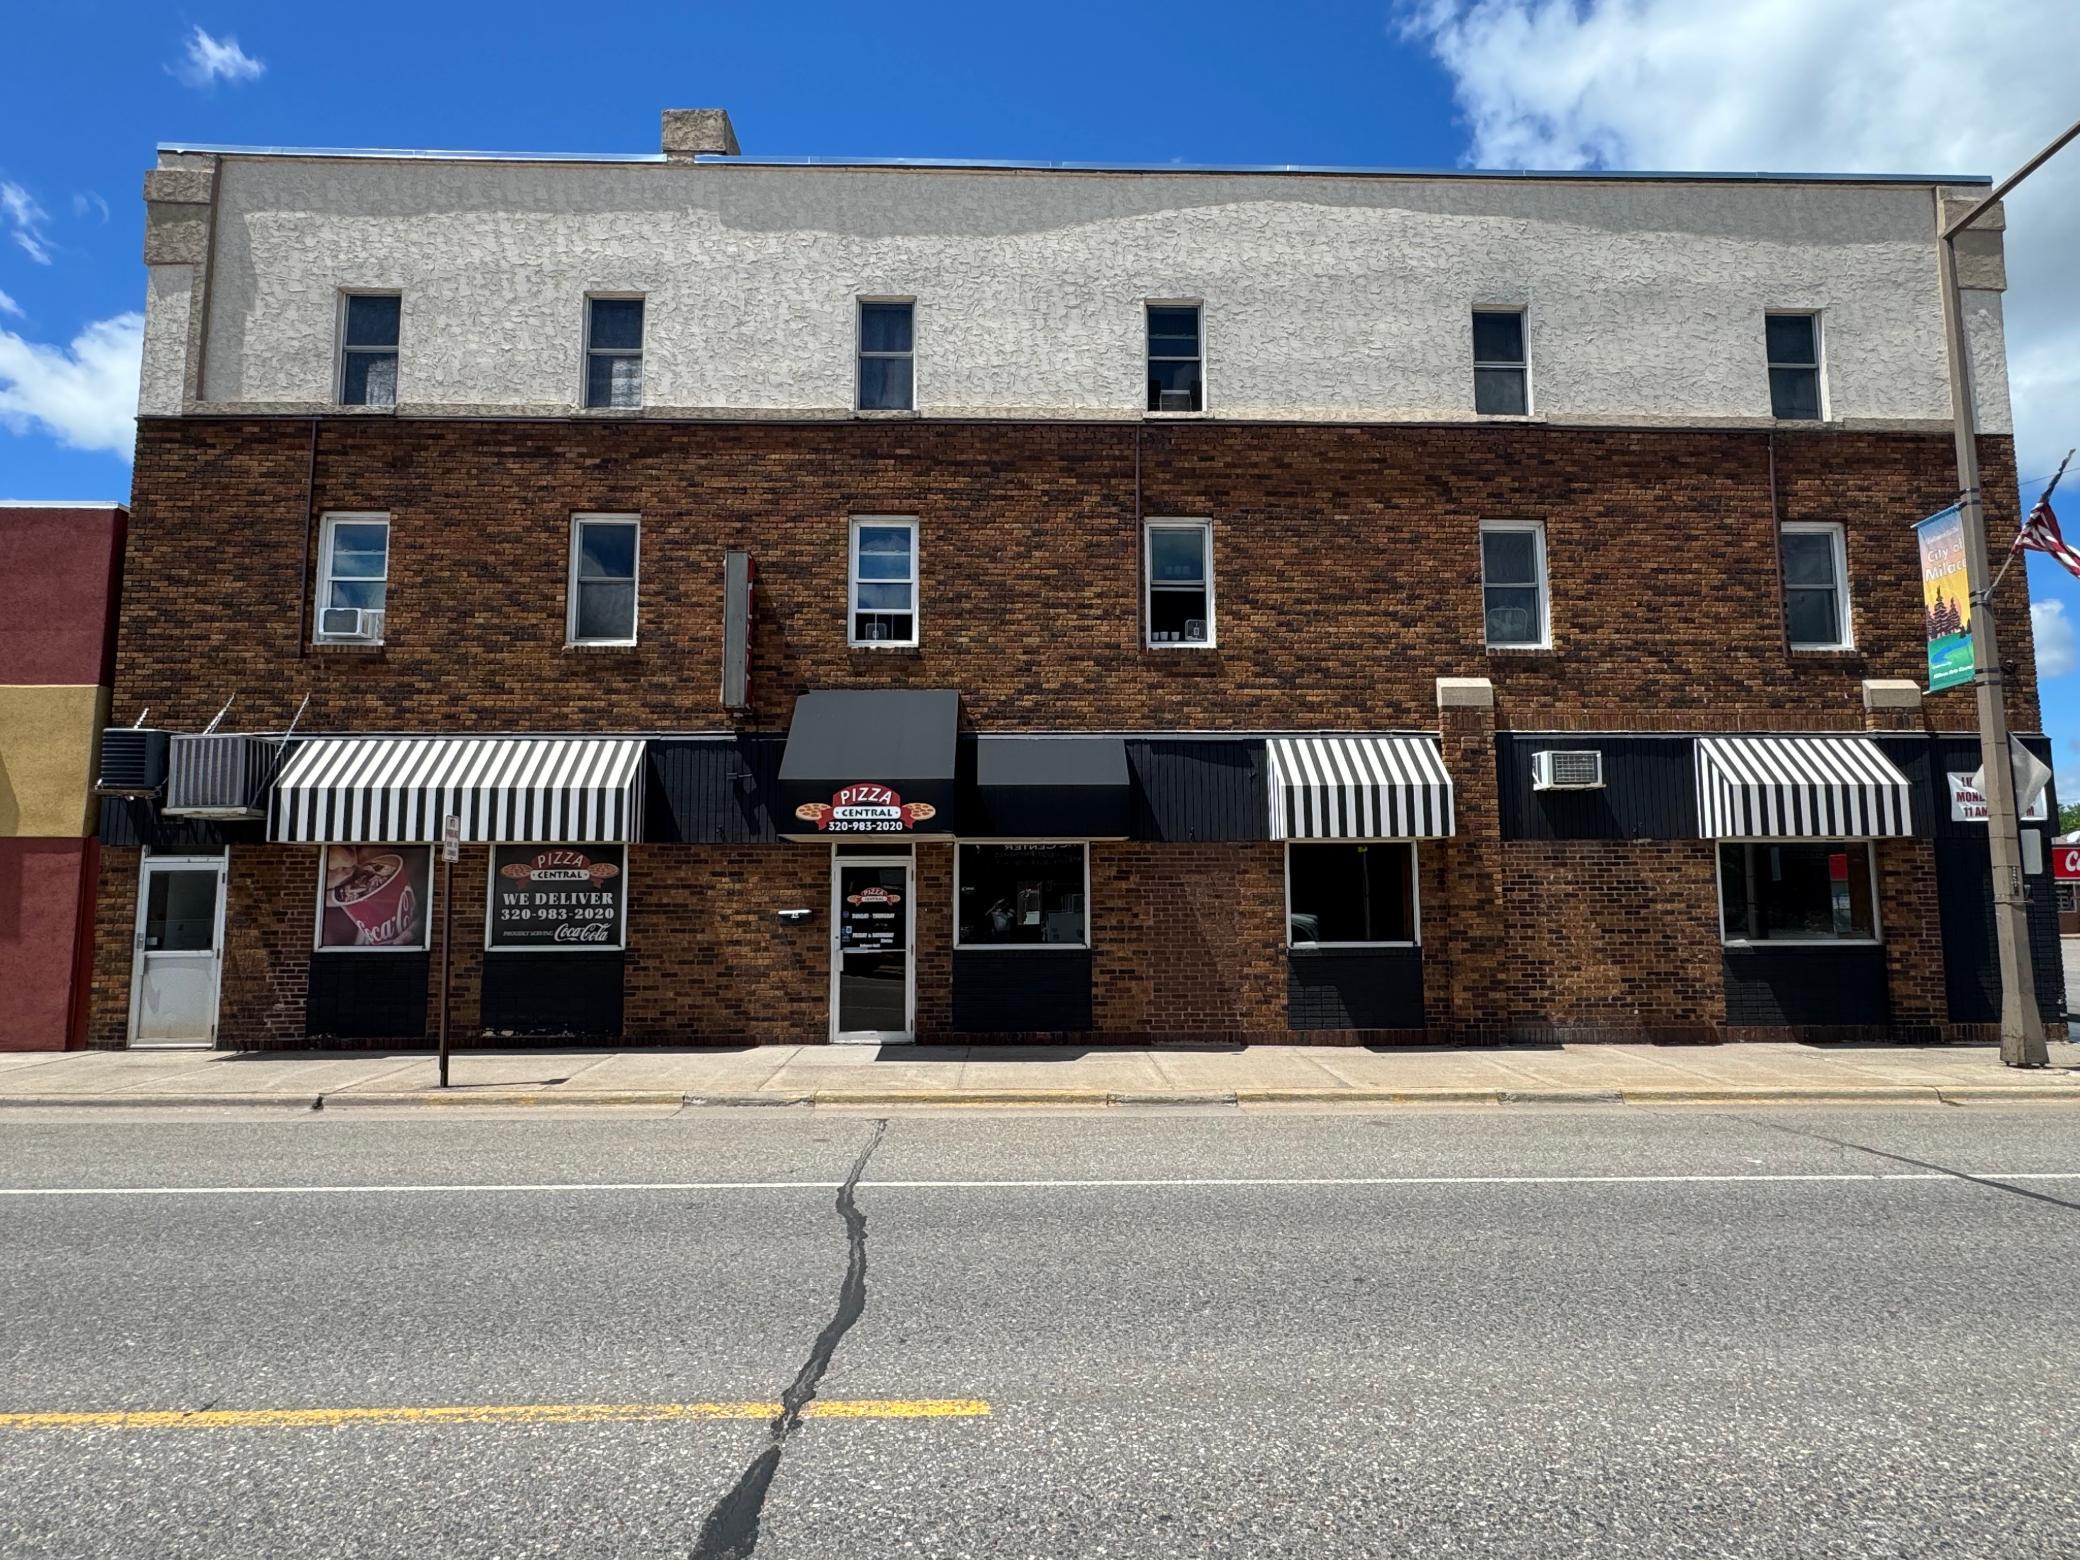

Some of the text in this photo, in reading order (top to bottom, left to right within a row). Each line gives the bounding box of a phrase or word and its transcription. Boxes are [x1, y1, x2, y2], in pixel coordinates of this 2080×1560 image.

[840, 787, 893, 805] PIZZA
[842, 808, 893, 817] CENTRAL
[828, 821, 903, 831] 320-983-2020
[537, 851, 584, 869] PIZZA
[537, 871, 583, 879] CENTRAL
[503, 892, 614, 906] WE DELIVER
[501, 908, 615, 920] 320-983-2020
